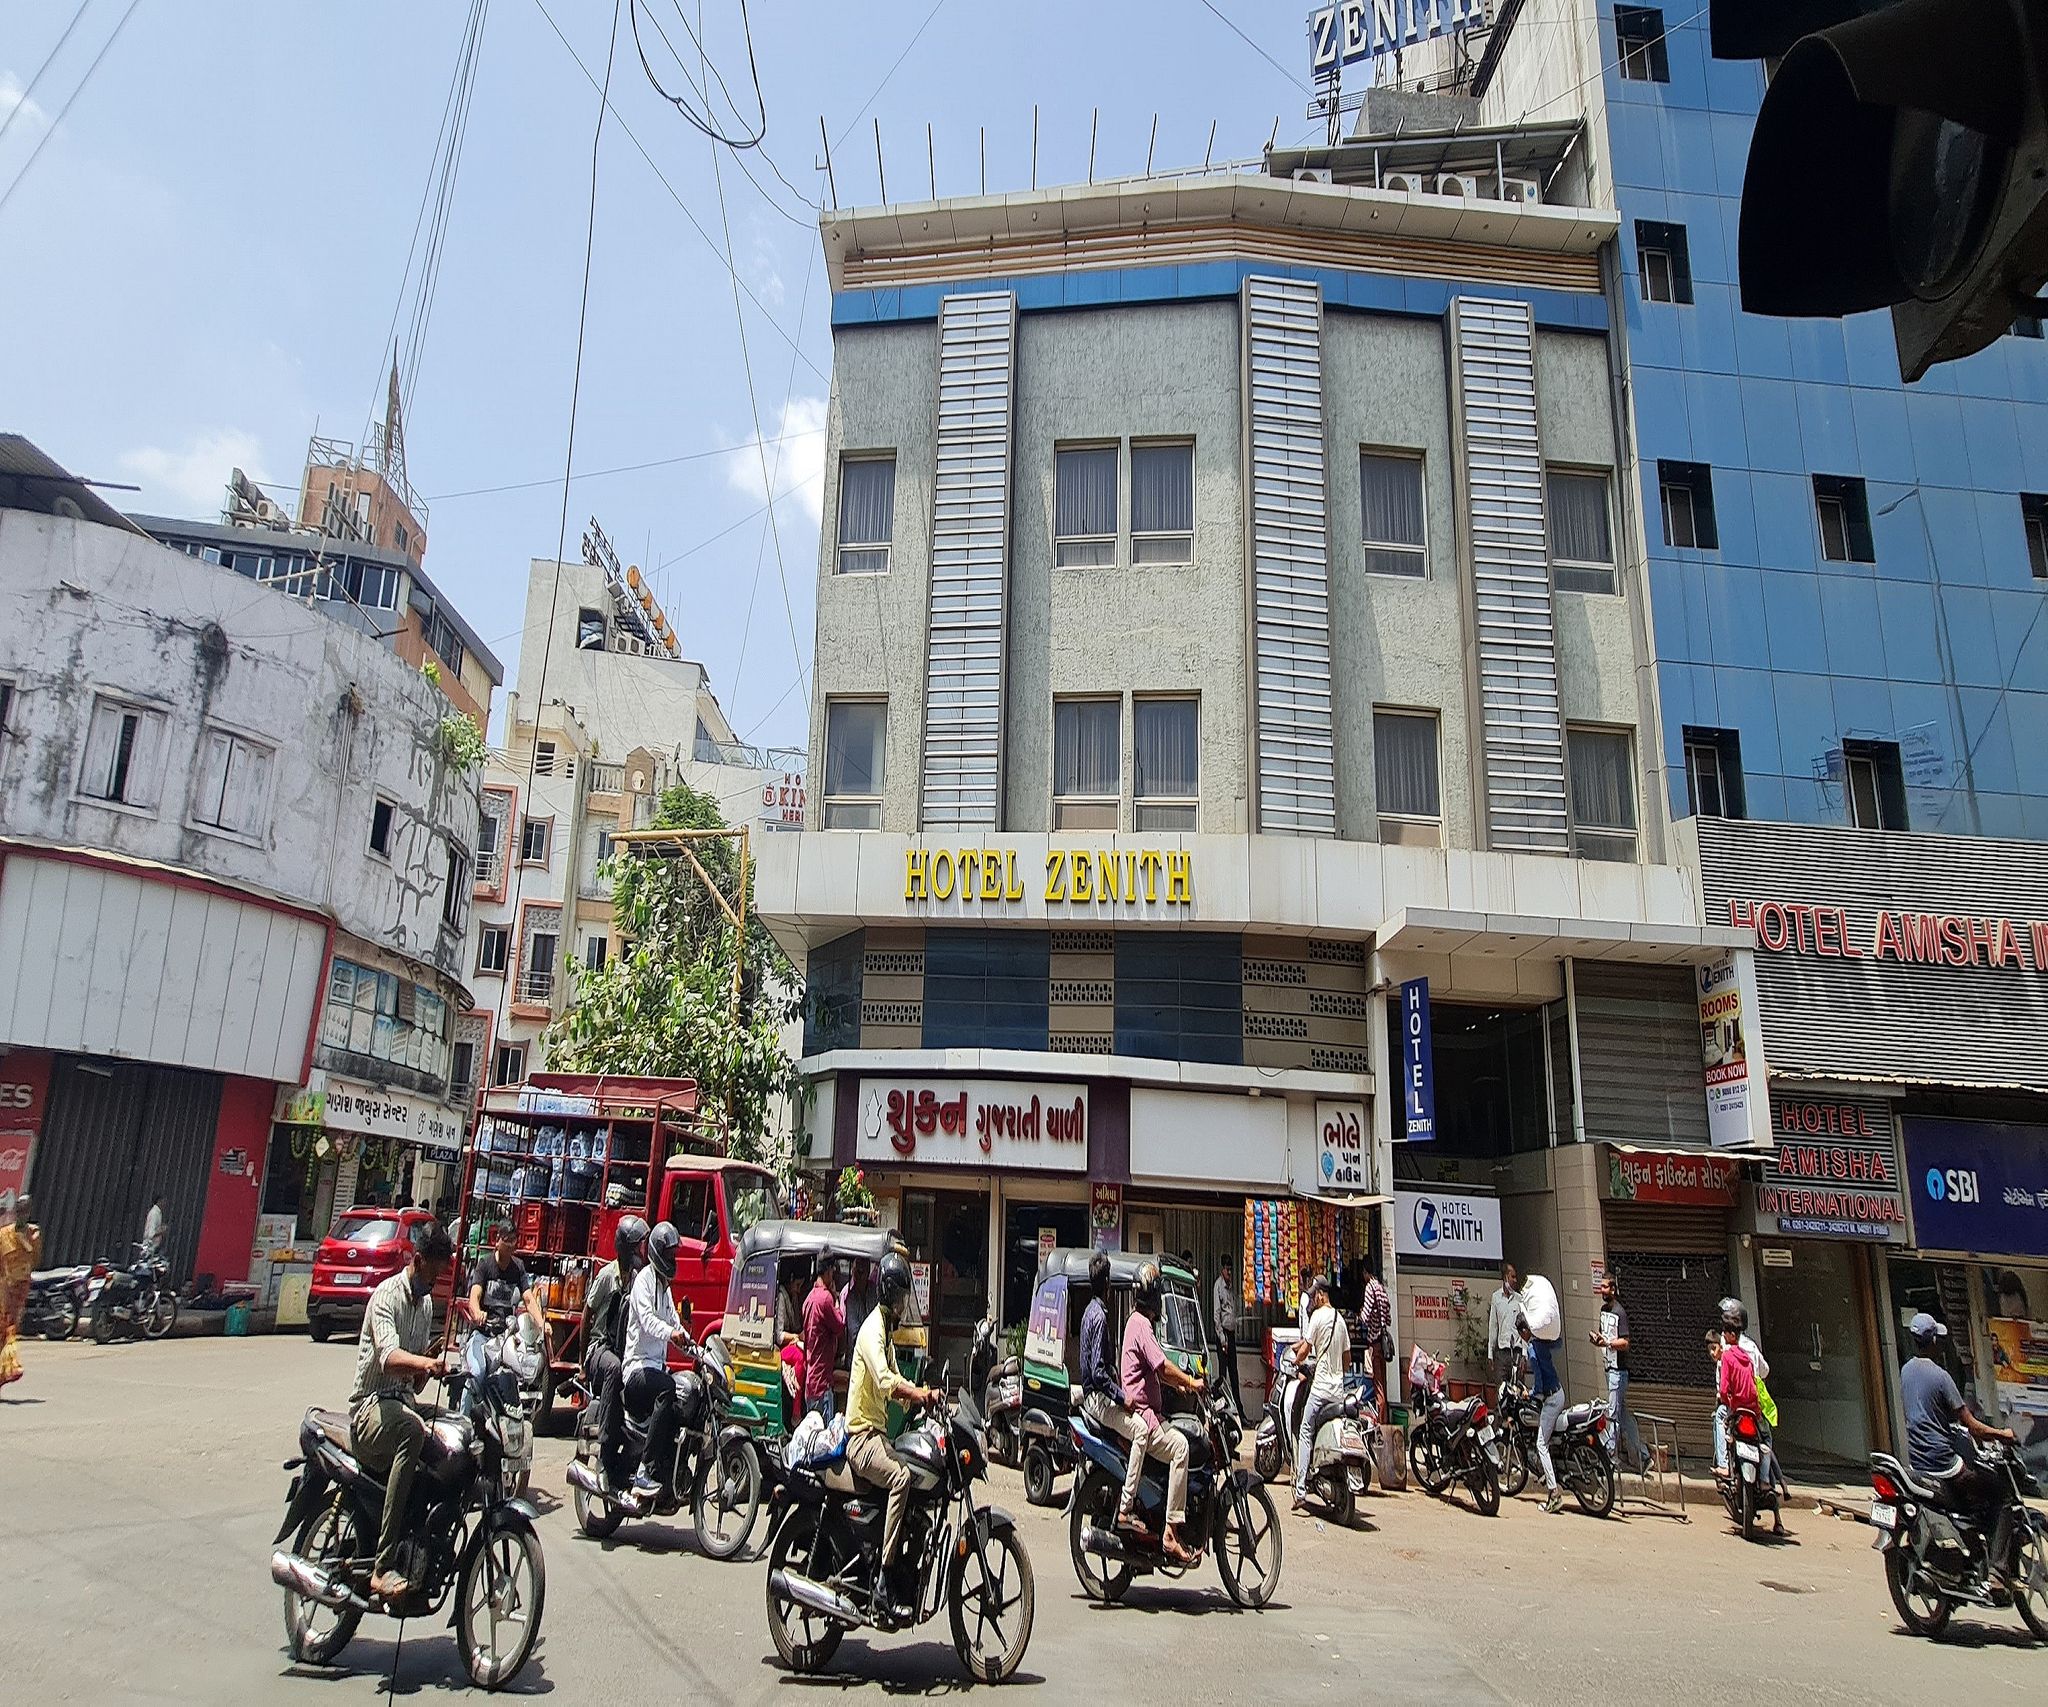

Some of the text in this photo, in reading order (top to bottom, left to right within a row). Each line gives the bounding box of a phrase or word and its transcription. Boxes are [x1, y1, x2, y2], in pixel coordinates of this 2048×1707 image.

[904, 849, 1192, 902] HOTEL ZENITH
[1728, 898, 1865, 957] HOTEL
[1873, 910, 2026, 970] AMISHA
[1701, 993, 1738, 1019] ROOMS
[1408, 986, 1424, 1114] HOTEL
[1706, 1062, 1746, 1083] BOOK NOW
[0, 1082, 33, 1108] ES
[886, 1089, 1085, 1153] શુકન ગુજરાતી થાળી
[1323, 1111, 1361, 1149] ભોલે
[1407, 1120, 1432, 1133] ZENITH
[1781, 1101, 1874, 1136] HOTEL
[431, 1150, 454, 1161] PLAZA
[1342, 1152, 1361, 1165] પાન
[1778, 1145, 1888, 1180] AMISHA
[1335, 1166, 1361, 1183] હાઉસ
[1946, 1169, 1980, 1203] SBI
[1442, 1201, 1473, 1216] HOTEL
[1758, 1186, 1905, 1222] INTERNATIONAL
[1414, 1295, 1449, 1307] PARKING AT
